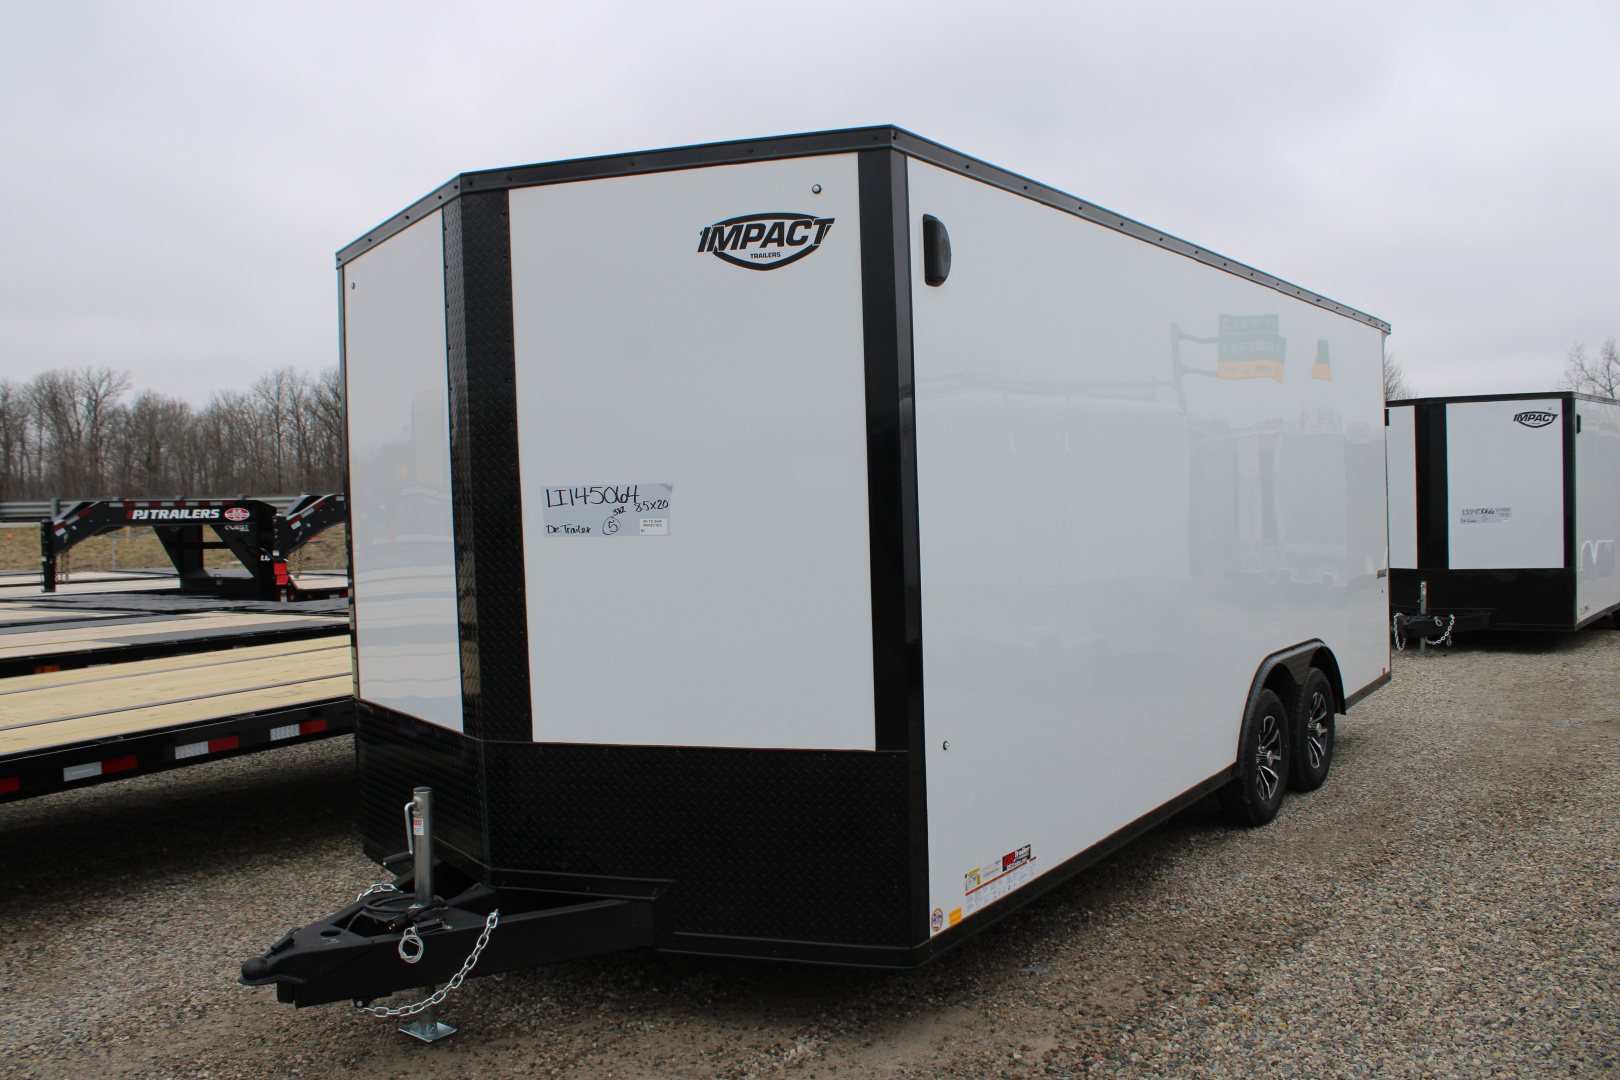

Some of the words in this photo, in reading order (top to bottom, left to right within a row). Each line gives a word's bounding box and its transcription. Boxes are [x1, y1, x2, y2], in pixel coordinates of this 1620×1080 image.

[697, 218, 835, 252] IMPACT
[1513, 414, 1558, 422] IMPACT
[132, 509, 149, 520] PJ
[150, 509, 220, 519] TRAILERS
[608, 520, 618, 533] 5
